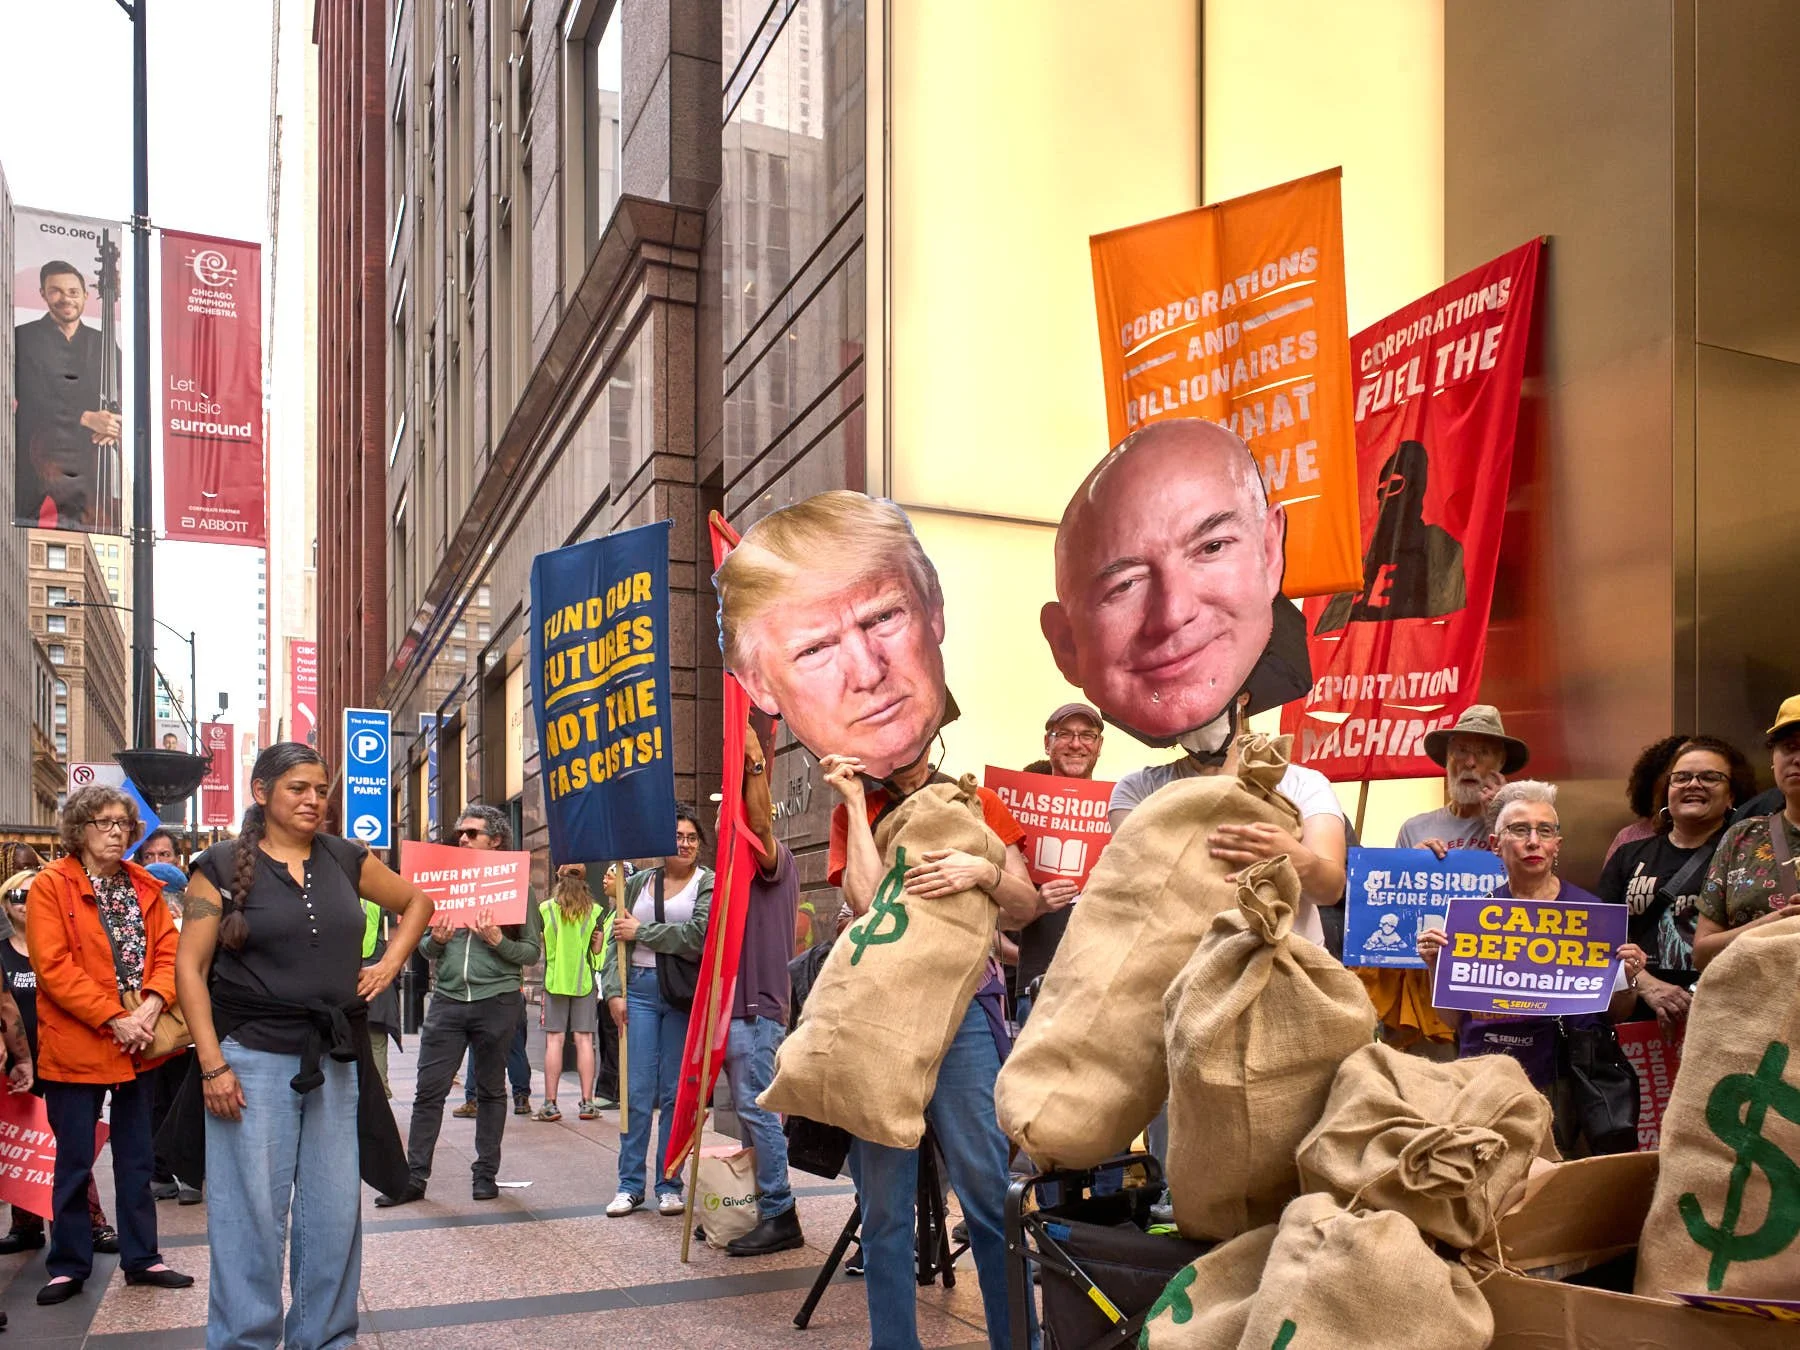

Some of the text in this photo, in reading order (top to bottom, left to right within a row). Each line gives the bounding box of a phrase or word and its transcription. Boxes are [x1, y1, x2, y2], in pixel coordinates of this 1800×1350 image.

[40, 223, 96, 240] CSO.ORG
[188, 296, 236, 309] SYMPHONY
[191, 288, 232, 300] CHICAGO
[1121, 246, 1319, 348] CORPORATIONS
[187, 304, 237, 318] ORCHESTRA
[1360, 277, 1512, 372] CORPORATIONS
[1187, 321, 1240, 362] AND
[1127, 330, 1318, 427] BILLIONAIRES
[1355, 324, 1504, 422] FUEL THE
[170, 374, 195, 392] Let
[170, 398, 221, 415] music
[170, 418, 252, 437] surround
[199, 518, 248, 533] ABBOTT
[544, 571, 652, 650] FUND OUR
[546, 678, 657, 760] NOT THE
[549, 726, 663, 801] FASCISTS!
[348, 776, 387, 786] PUBLIC
[353, 786, 382, 795] PARK
[998, 786, 1109, 818] CLASSROO
[413, 862, 518, 883] LOWER MY RENT
[1634, 862, 1645, 877] I
[450, 882, 476, 895] NOT
[1626, 876, 1657, 895] AM
[479, 889, 517, 905] TAXES
[1367, 891, 1427, 906] BEFORE
[1479, 905, 1588, 936] CARE
[1452, 933, 1611, 968] BEFORE
[1451, 962, 1604, 991] Billionaires
[20, 1128, 49, 1146] MY
[0, 1141, 35, 1162] NOT
[25, 1168, 54, 1187] TAX
